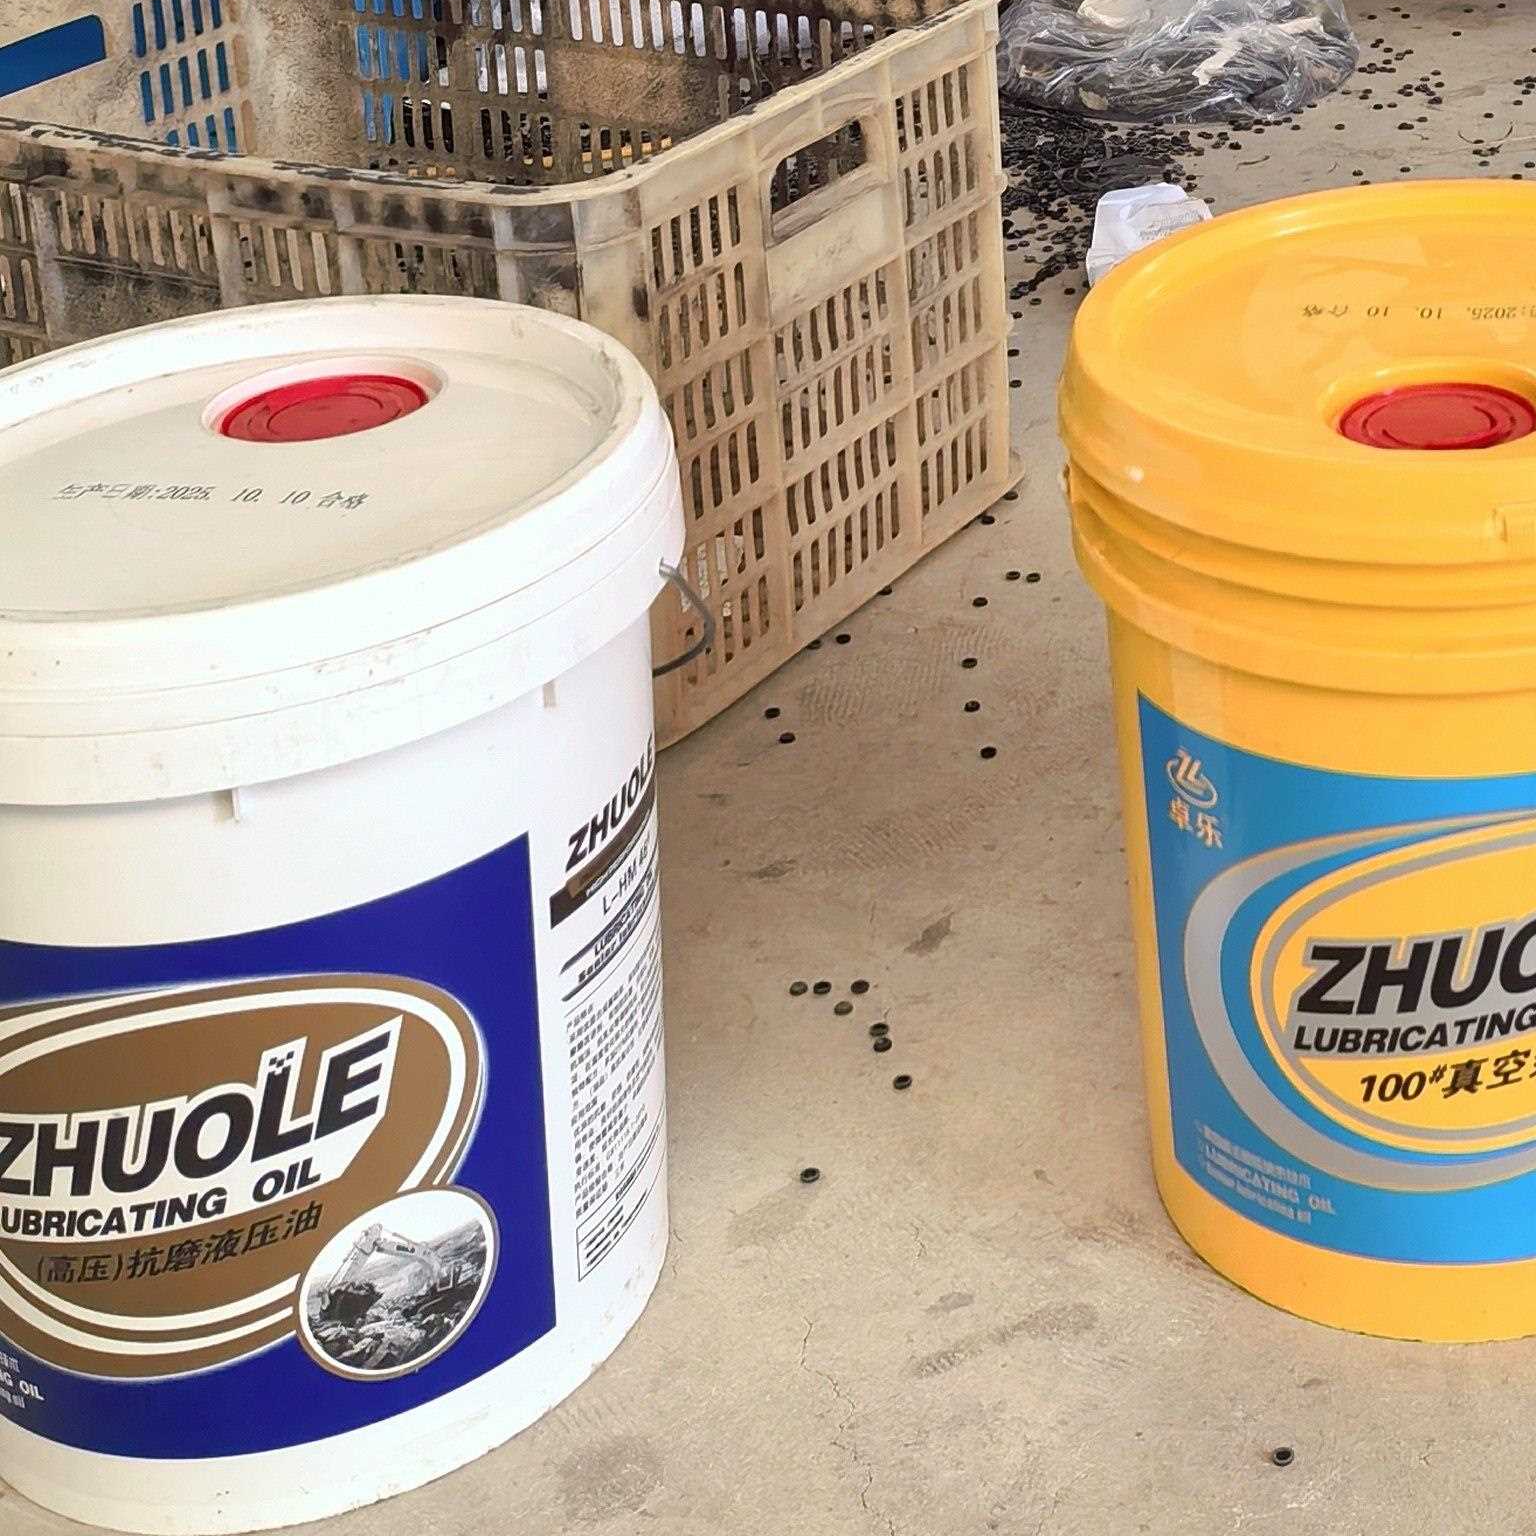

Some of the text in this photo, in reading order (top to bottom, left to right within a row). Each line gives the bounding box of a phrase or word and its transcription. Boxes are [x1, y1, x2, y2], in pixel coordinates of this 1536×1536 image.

[0, 1156, 321, 1238] UBRICATING OIL
[36, 1198, 324, 1285] (高压)抗磨液压油
[19, 1379, 46, 1401] OIL
